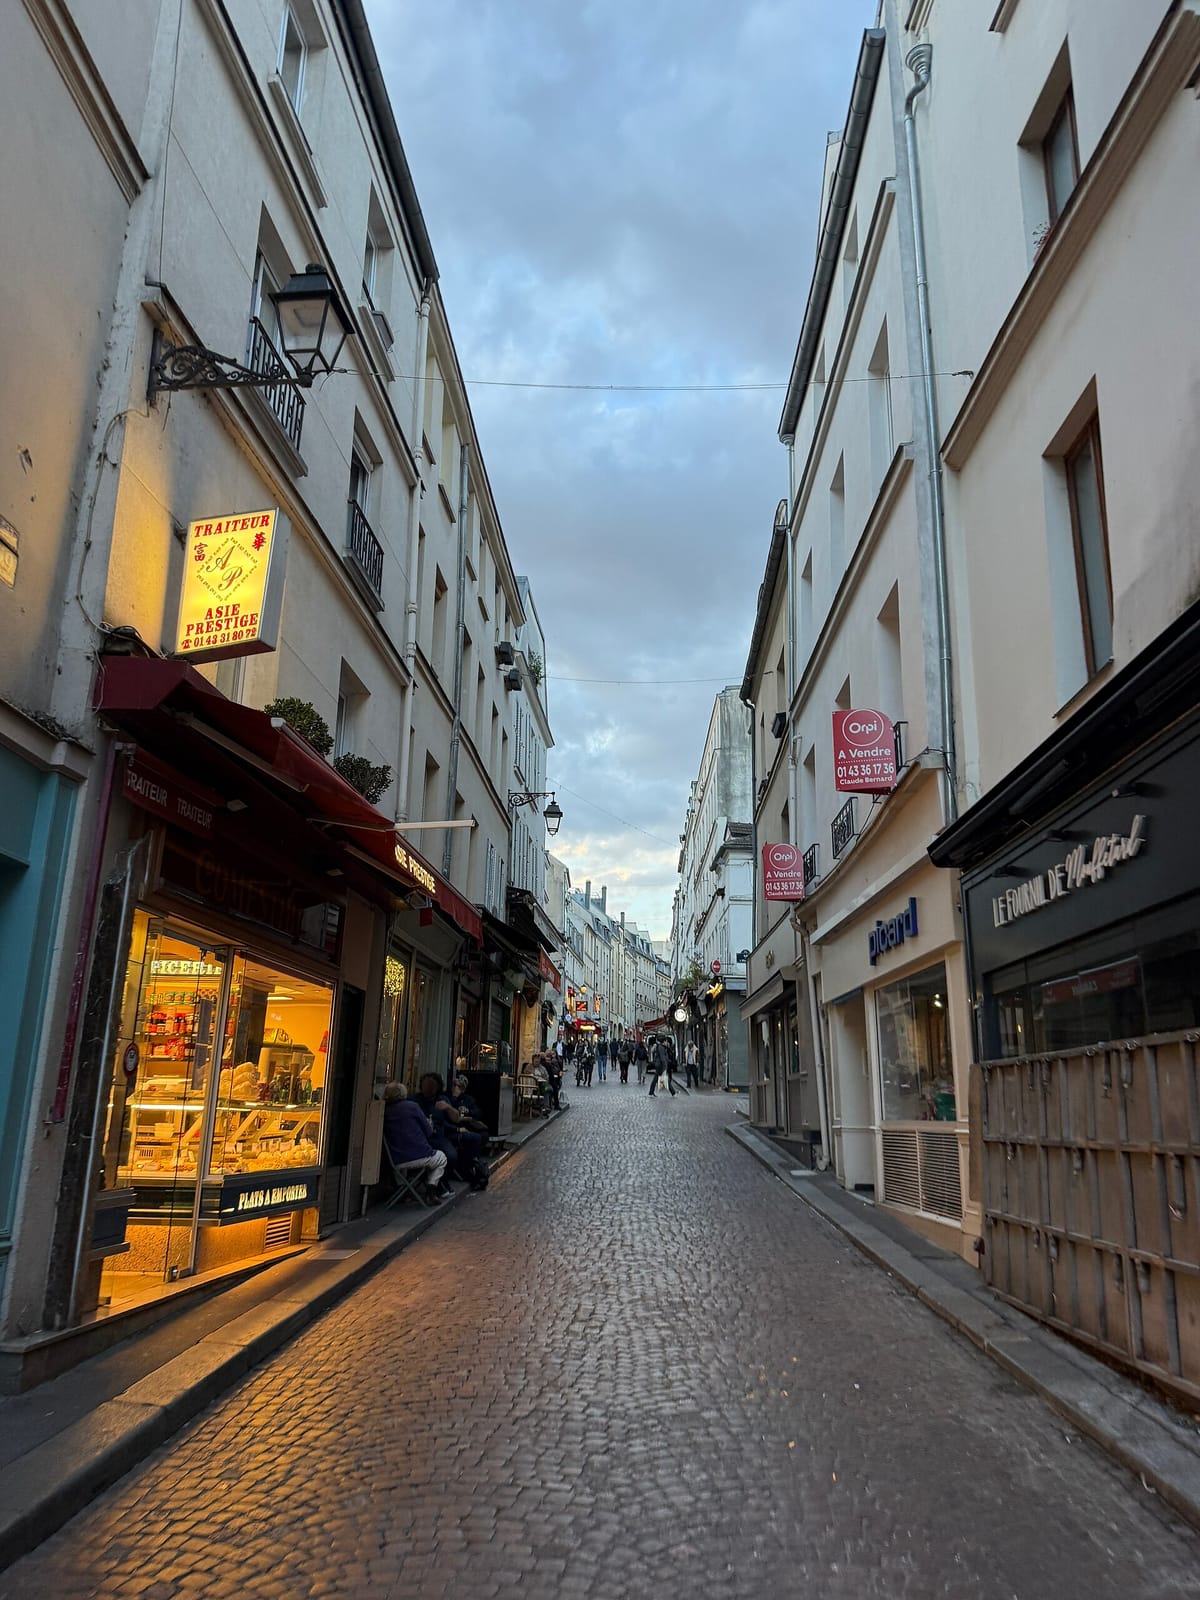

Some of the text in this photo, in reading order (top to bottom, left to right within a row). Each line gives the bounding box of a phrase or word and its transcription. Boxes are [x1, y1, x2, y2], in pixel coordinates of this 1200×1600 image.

[194, 514, 270, 538] TRAITEUR
[194, 542, 208, 562] 富
[204, 603, 240, 620] ASIE
[185, 613, 259, 636] PRESTIGE
[848, 720, 878, 735] Orpi
[838, 746, 892, 760] A Vendre
[837, 762, 895, 778] 01 43 36 17 36
[839, 774, 893, 785] Claude Bernard
[127, 769, 213, 830] TRAITEUR TRAITEUR
[773, 852, 793, 862] Orpi
[766, 870, 802, 879] A Vendre
[992, 896, 1008, 928] LE
[1005, 874, 1050, 921] FOURNIL
[1048, 863, 1070, 900] DE
[868, 896, 918, 967] picard
[237, 1189, 264, 1211] PLATS
[270, 1183, 308, 1205] EMPORTER
